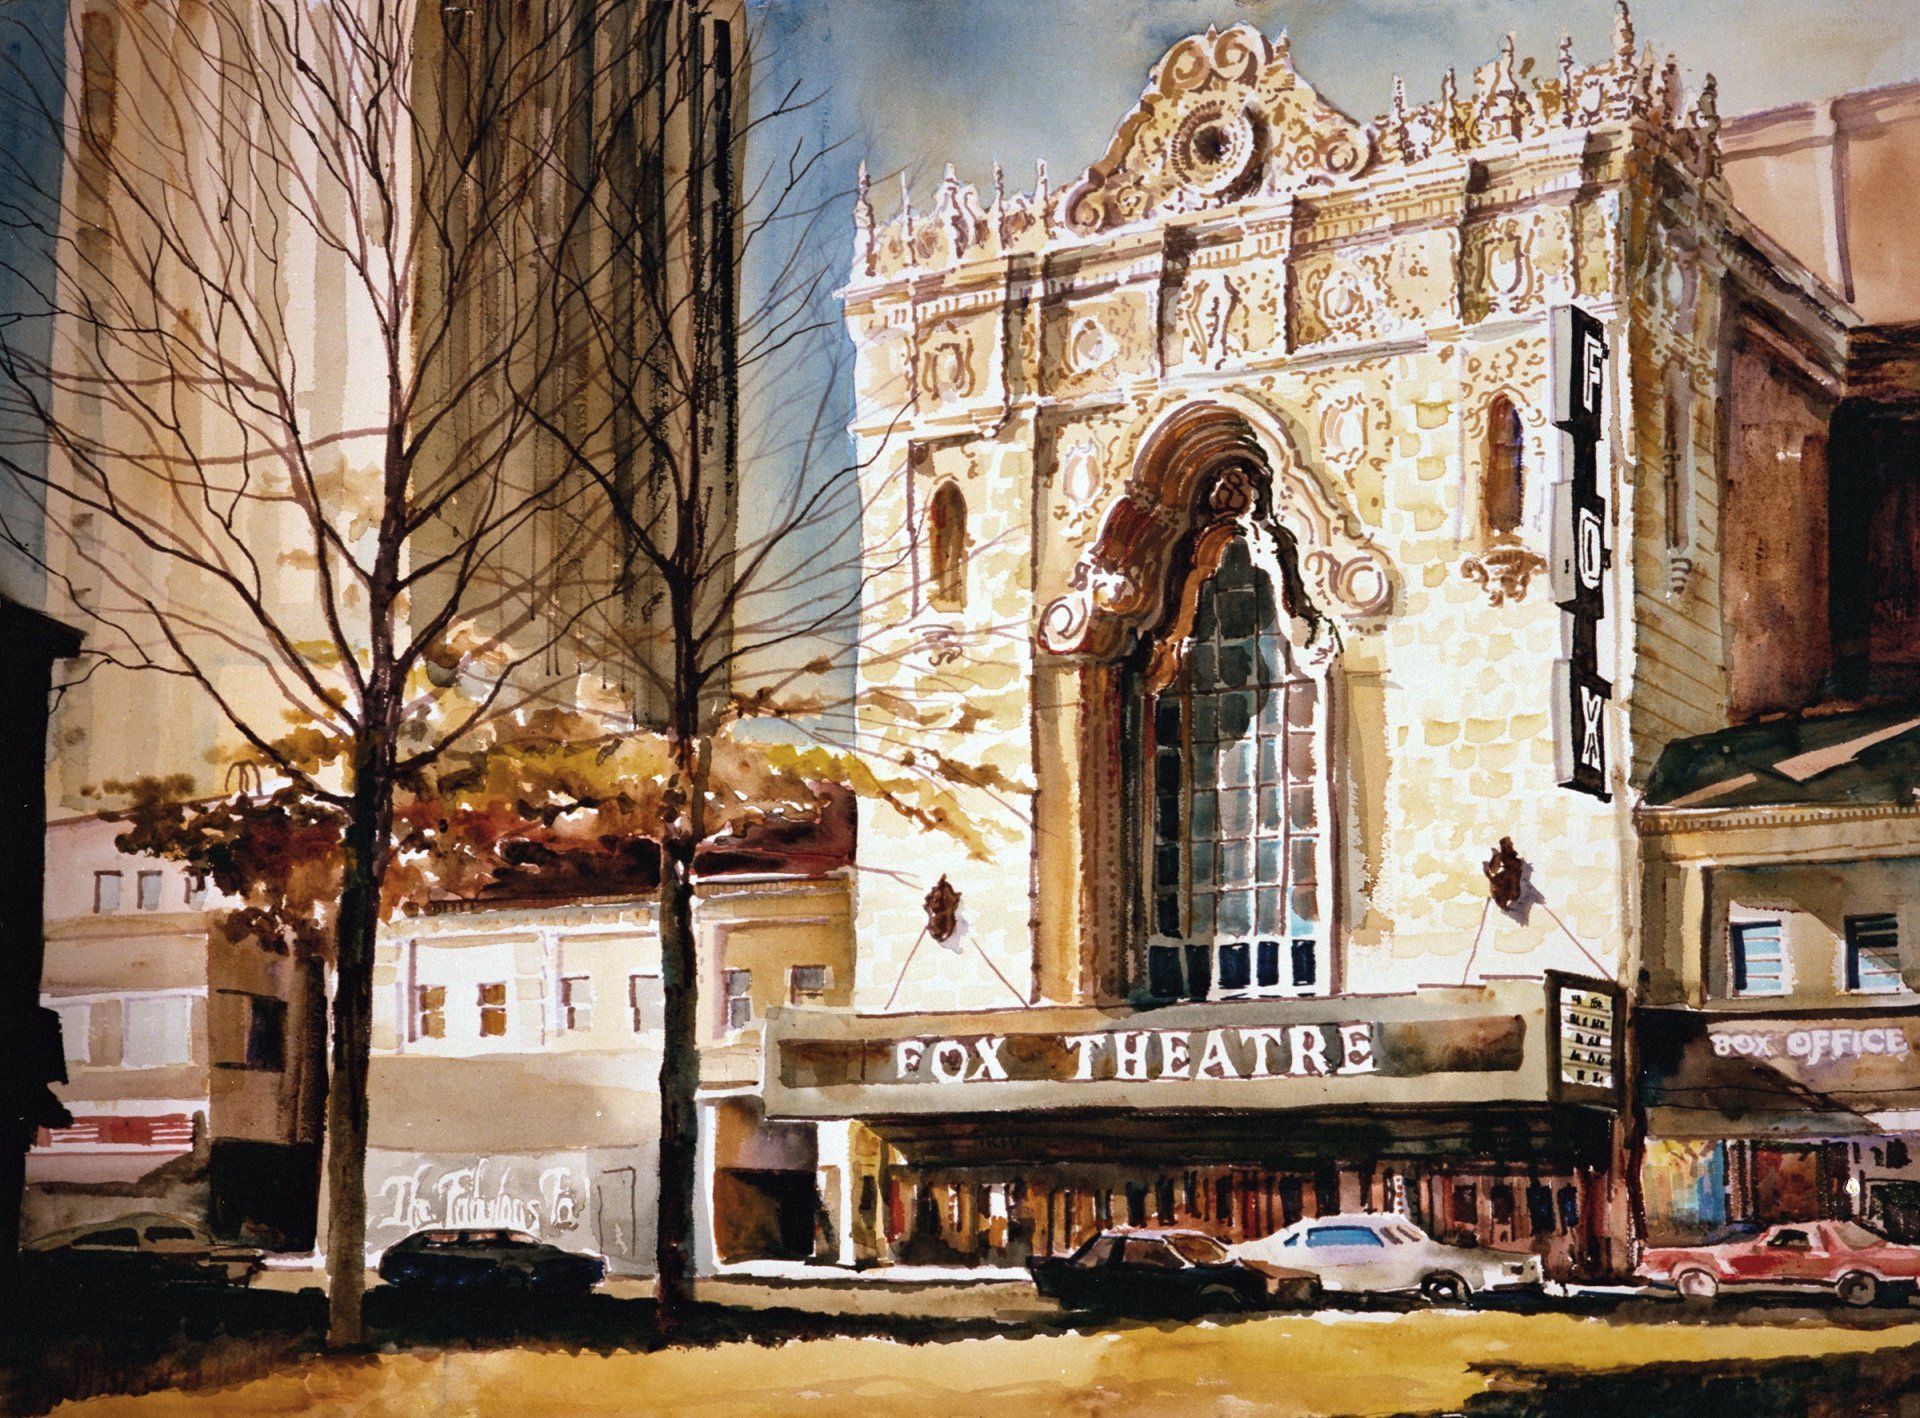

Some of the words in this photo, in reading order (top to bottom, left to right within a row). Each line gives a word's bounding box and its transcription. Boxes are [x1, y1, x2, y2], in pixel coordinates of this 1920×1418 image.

[1579, 330, 1603, 771] FOX
[897, 1036, 1008, 1083] FOX
[1065, 1023, 1376, 1081] THEATRE
[1709, 1033, 1774, 1057] BOX
[1786, 1027, 1909, 1065] OFFICE
